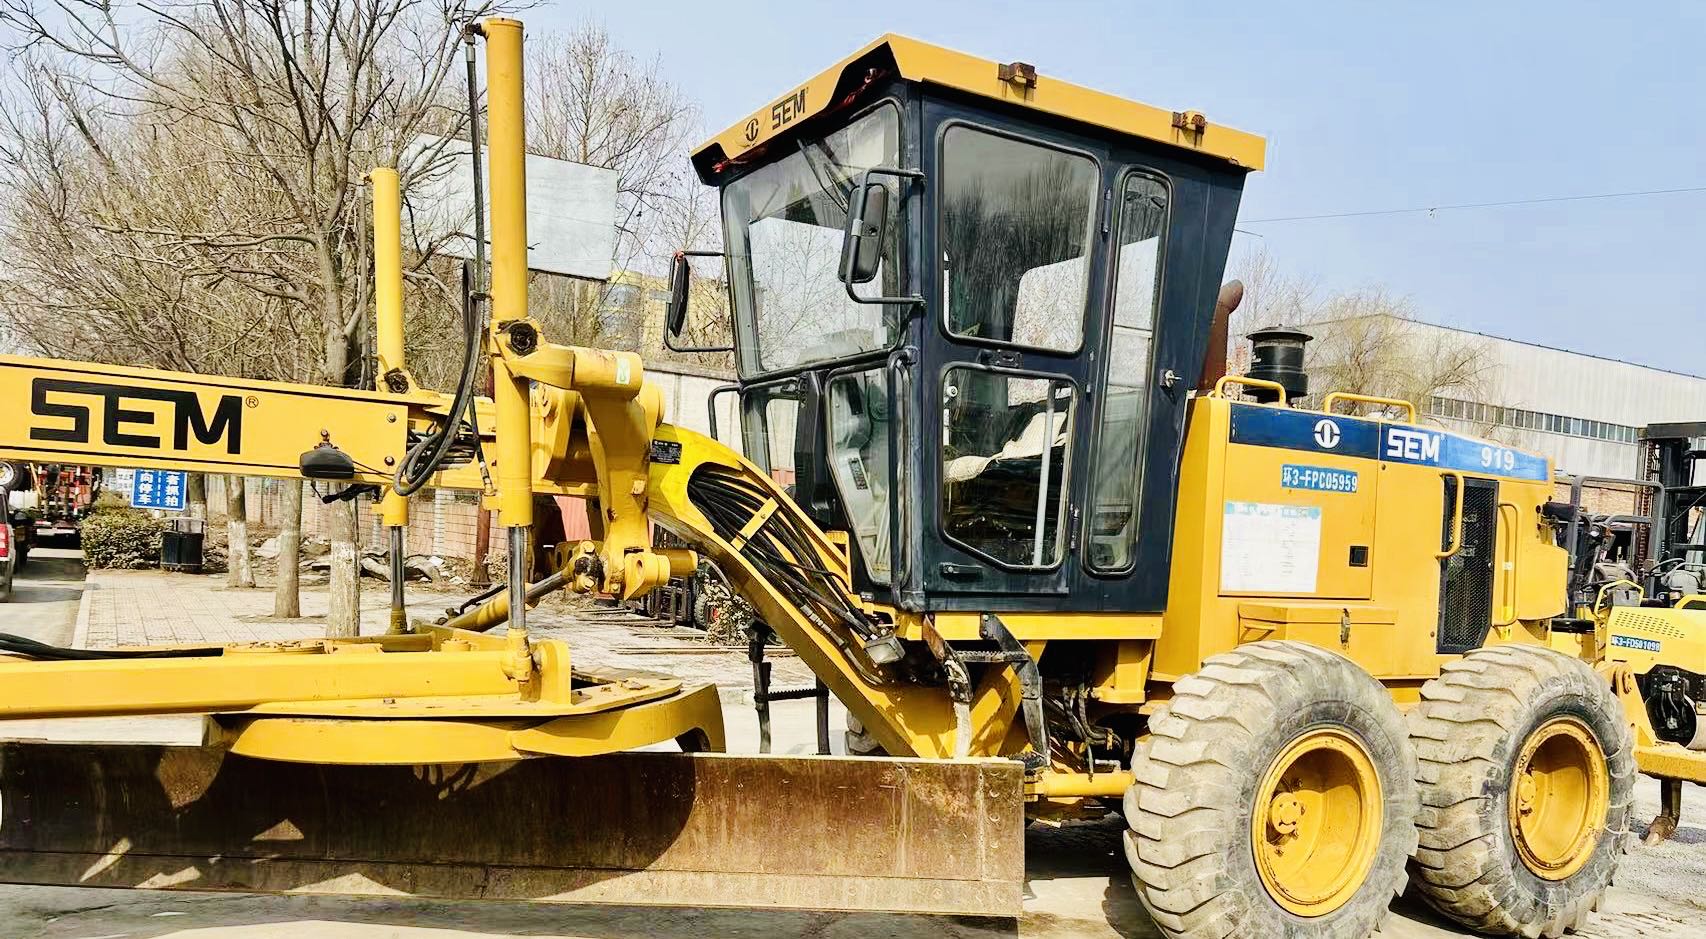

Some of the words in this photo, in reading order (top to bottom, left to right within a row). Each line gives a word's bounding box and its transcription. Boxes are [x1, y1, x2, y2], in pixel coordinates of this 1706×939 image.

[772, 89, 805, 130] SEM
[1387, 428, 1440, 462] SEM
[1481, 447, 1515, 471] 919
[138, 469, 155, 504] 向停车
[164, 471, 180, 506] 者抓拍
[1283, 466, 1358, 492] 环3-FPC05959
